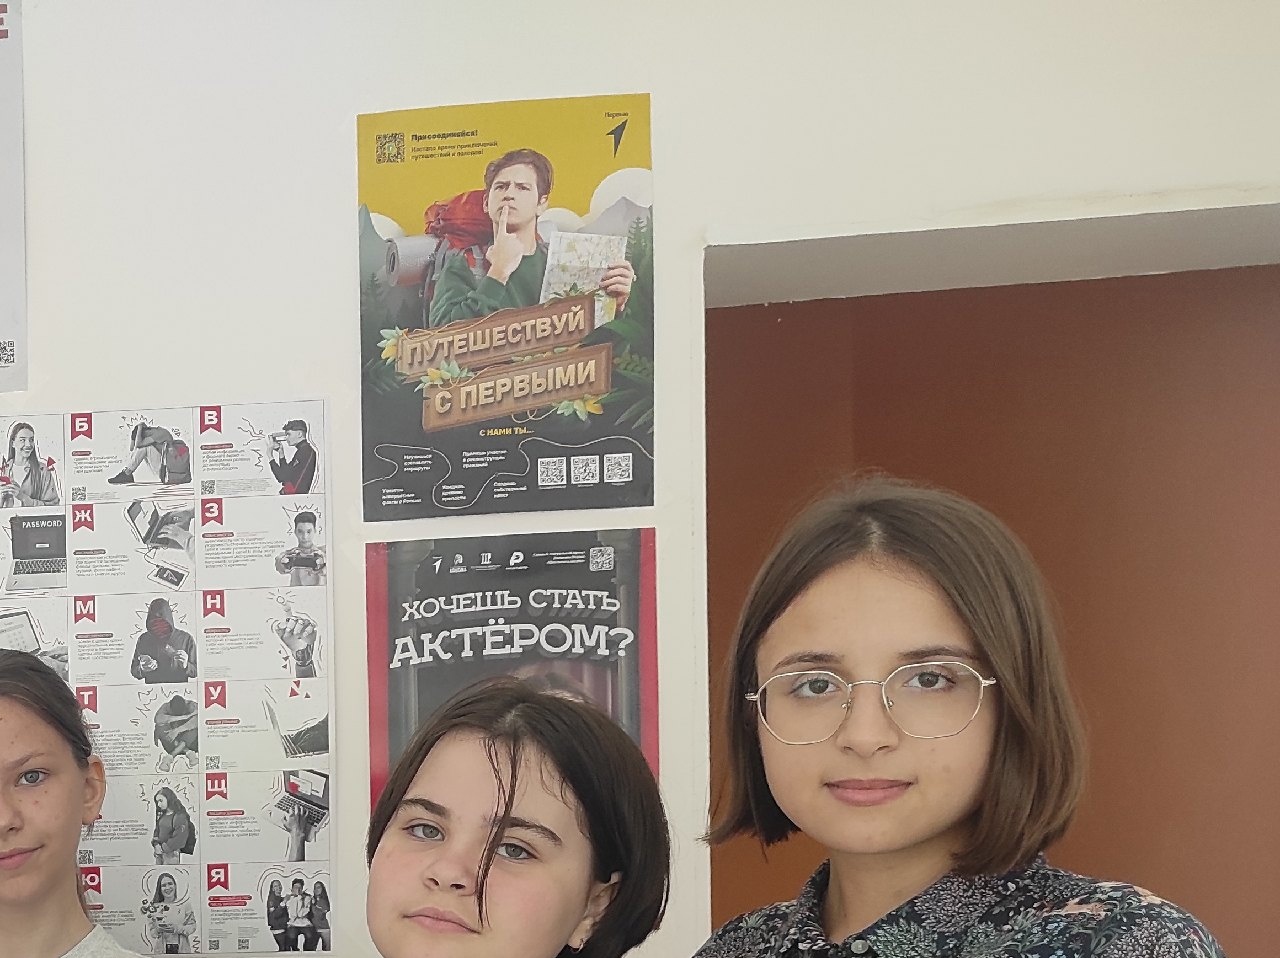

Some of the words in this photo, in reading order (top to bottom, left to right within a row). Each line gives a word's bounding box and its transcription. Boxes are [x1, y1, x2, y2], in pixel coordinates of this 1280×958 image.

[406, 306, 585, 365] ПУТЕШЕСТВУЙ
[434, 390, 452, 414] С
[460, 360, 596, 409] ПЕРВЫМИ
[401, 590, 521, 622] ХОЧЕШЬ
[528, 589, 621, 612] СТАТЬ
[389, 617, 634, 669] АКТЁРОМ?
